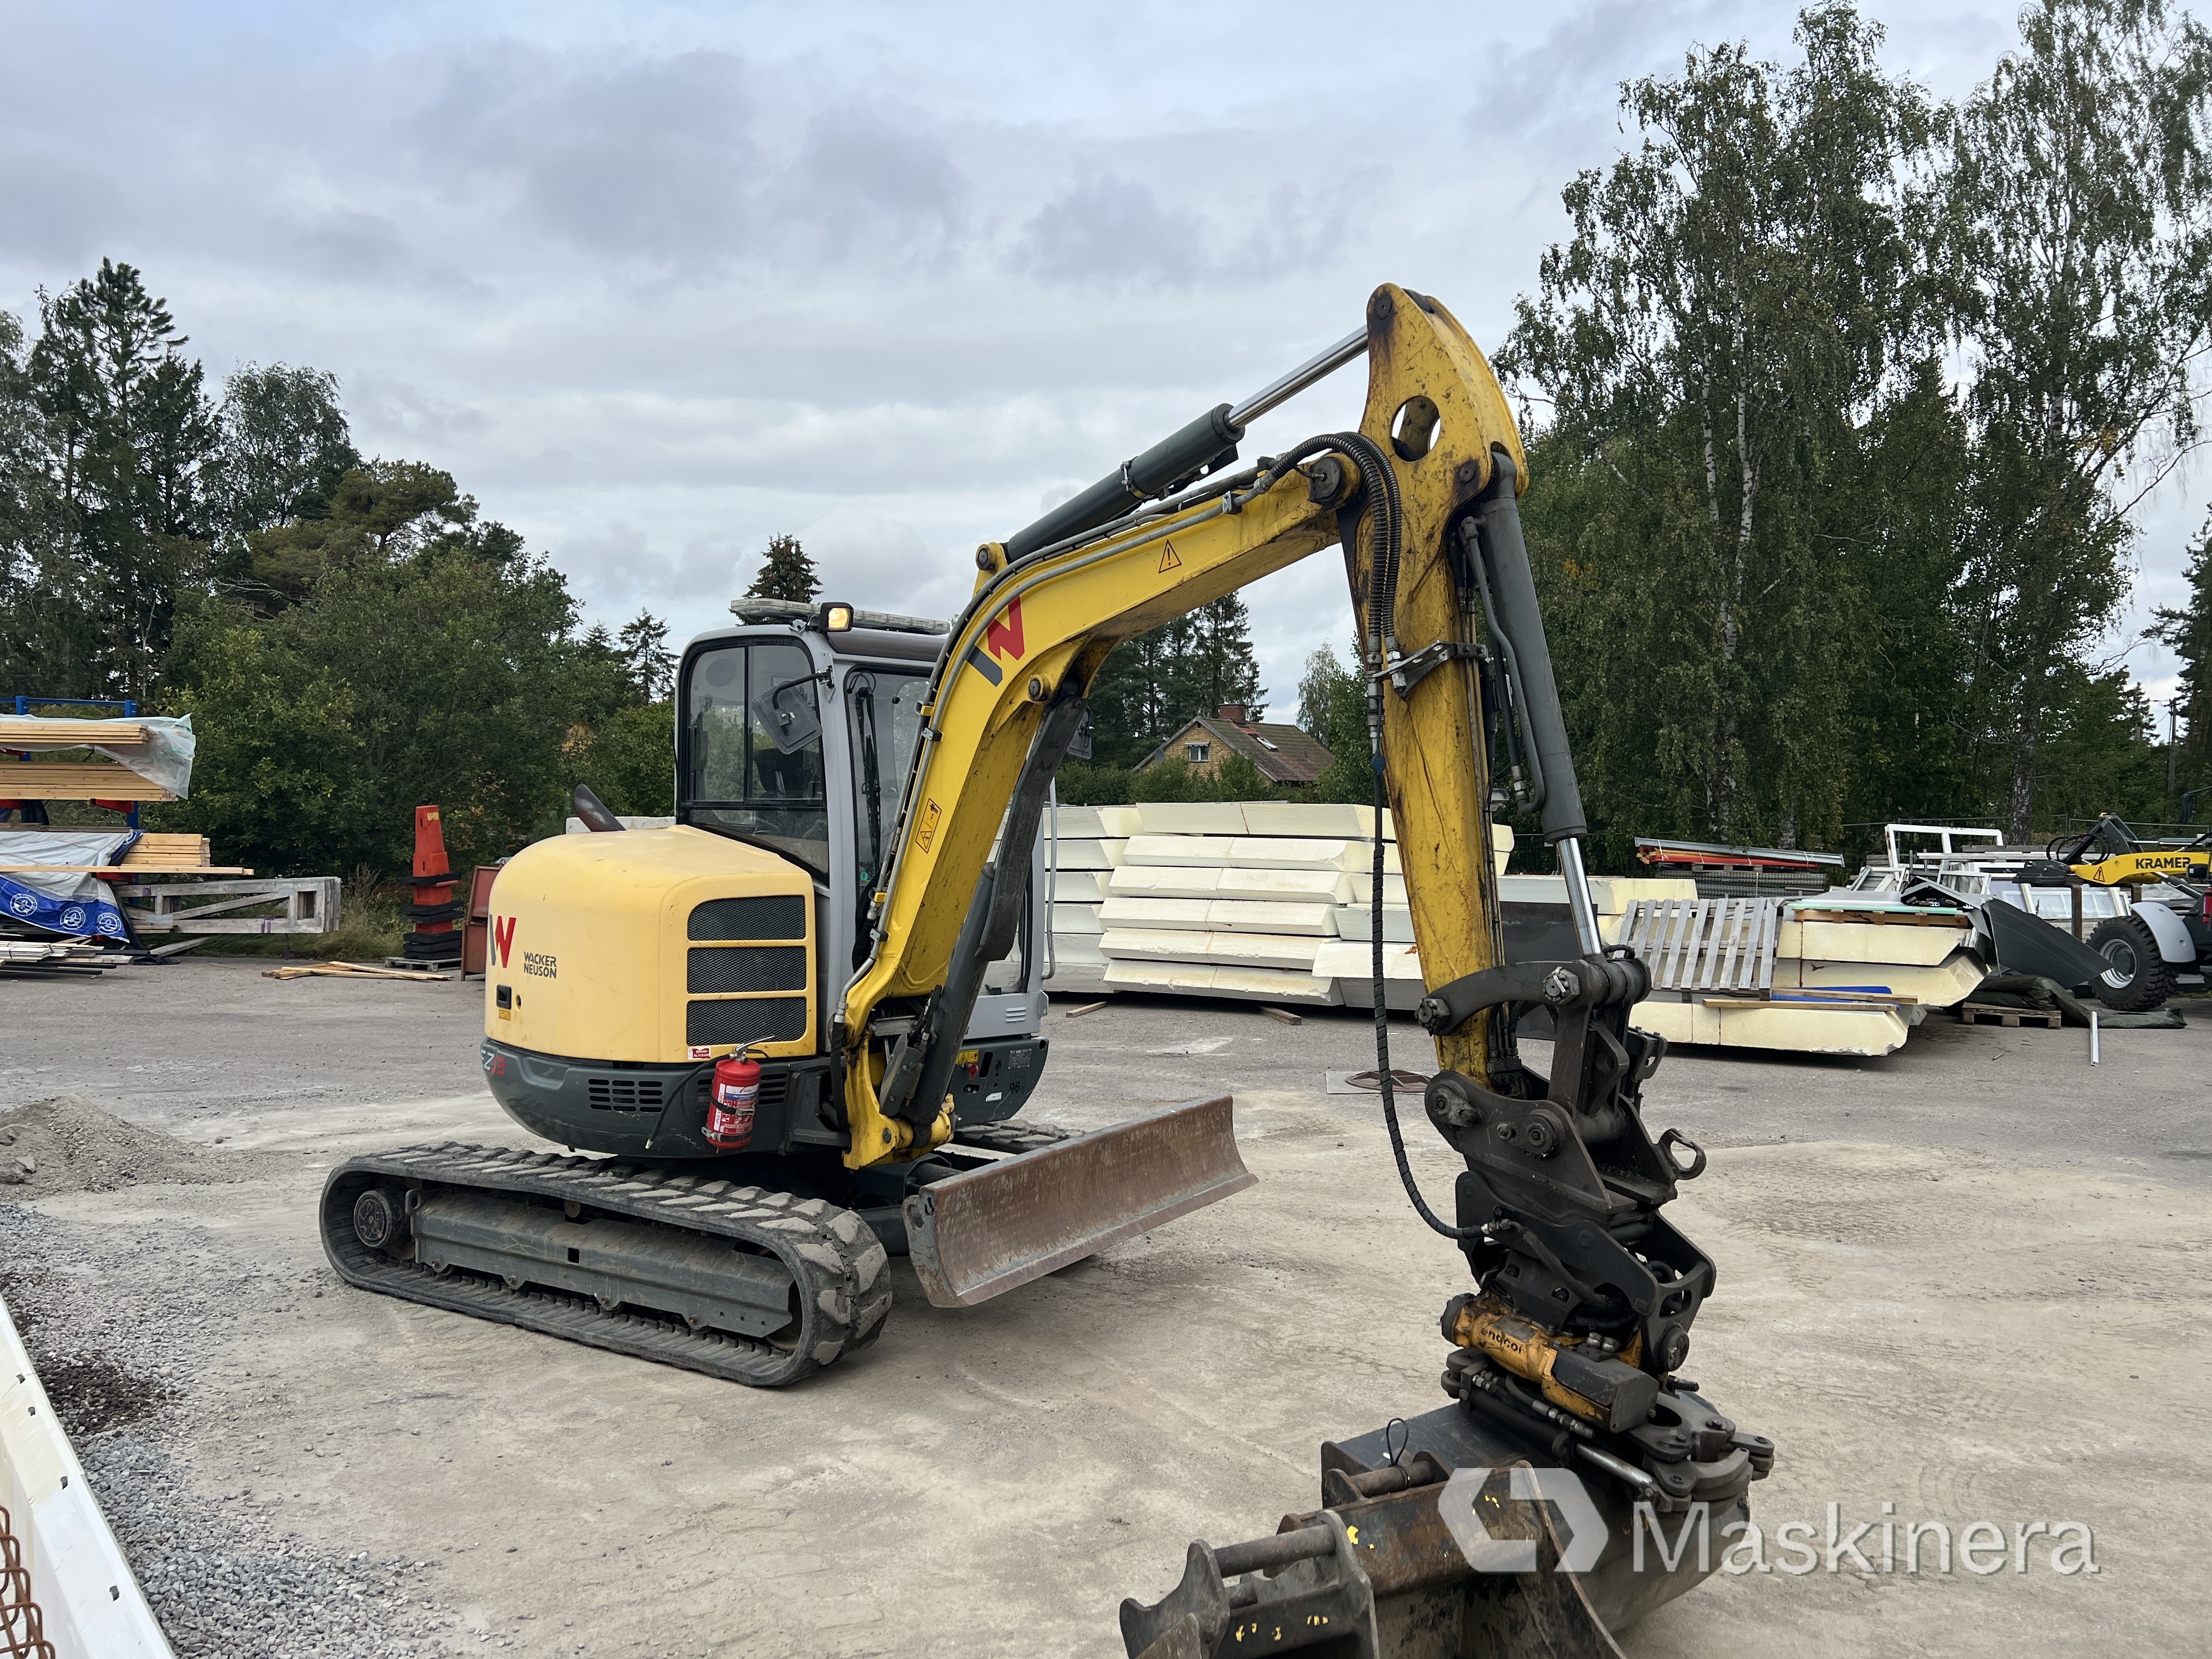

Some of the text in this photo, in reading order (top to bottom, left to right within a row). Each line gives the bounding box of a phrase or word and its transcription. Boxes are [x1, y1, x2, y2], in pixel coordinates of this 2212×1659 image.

[2136, 857, 2191, 870] KRAMER
[524, 951, 557, 967] WACKER
[524, 963, 557, 979] NEUSON
[1009, 1081, 1020, 1094] 96
